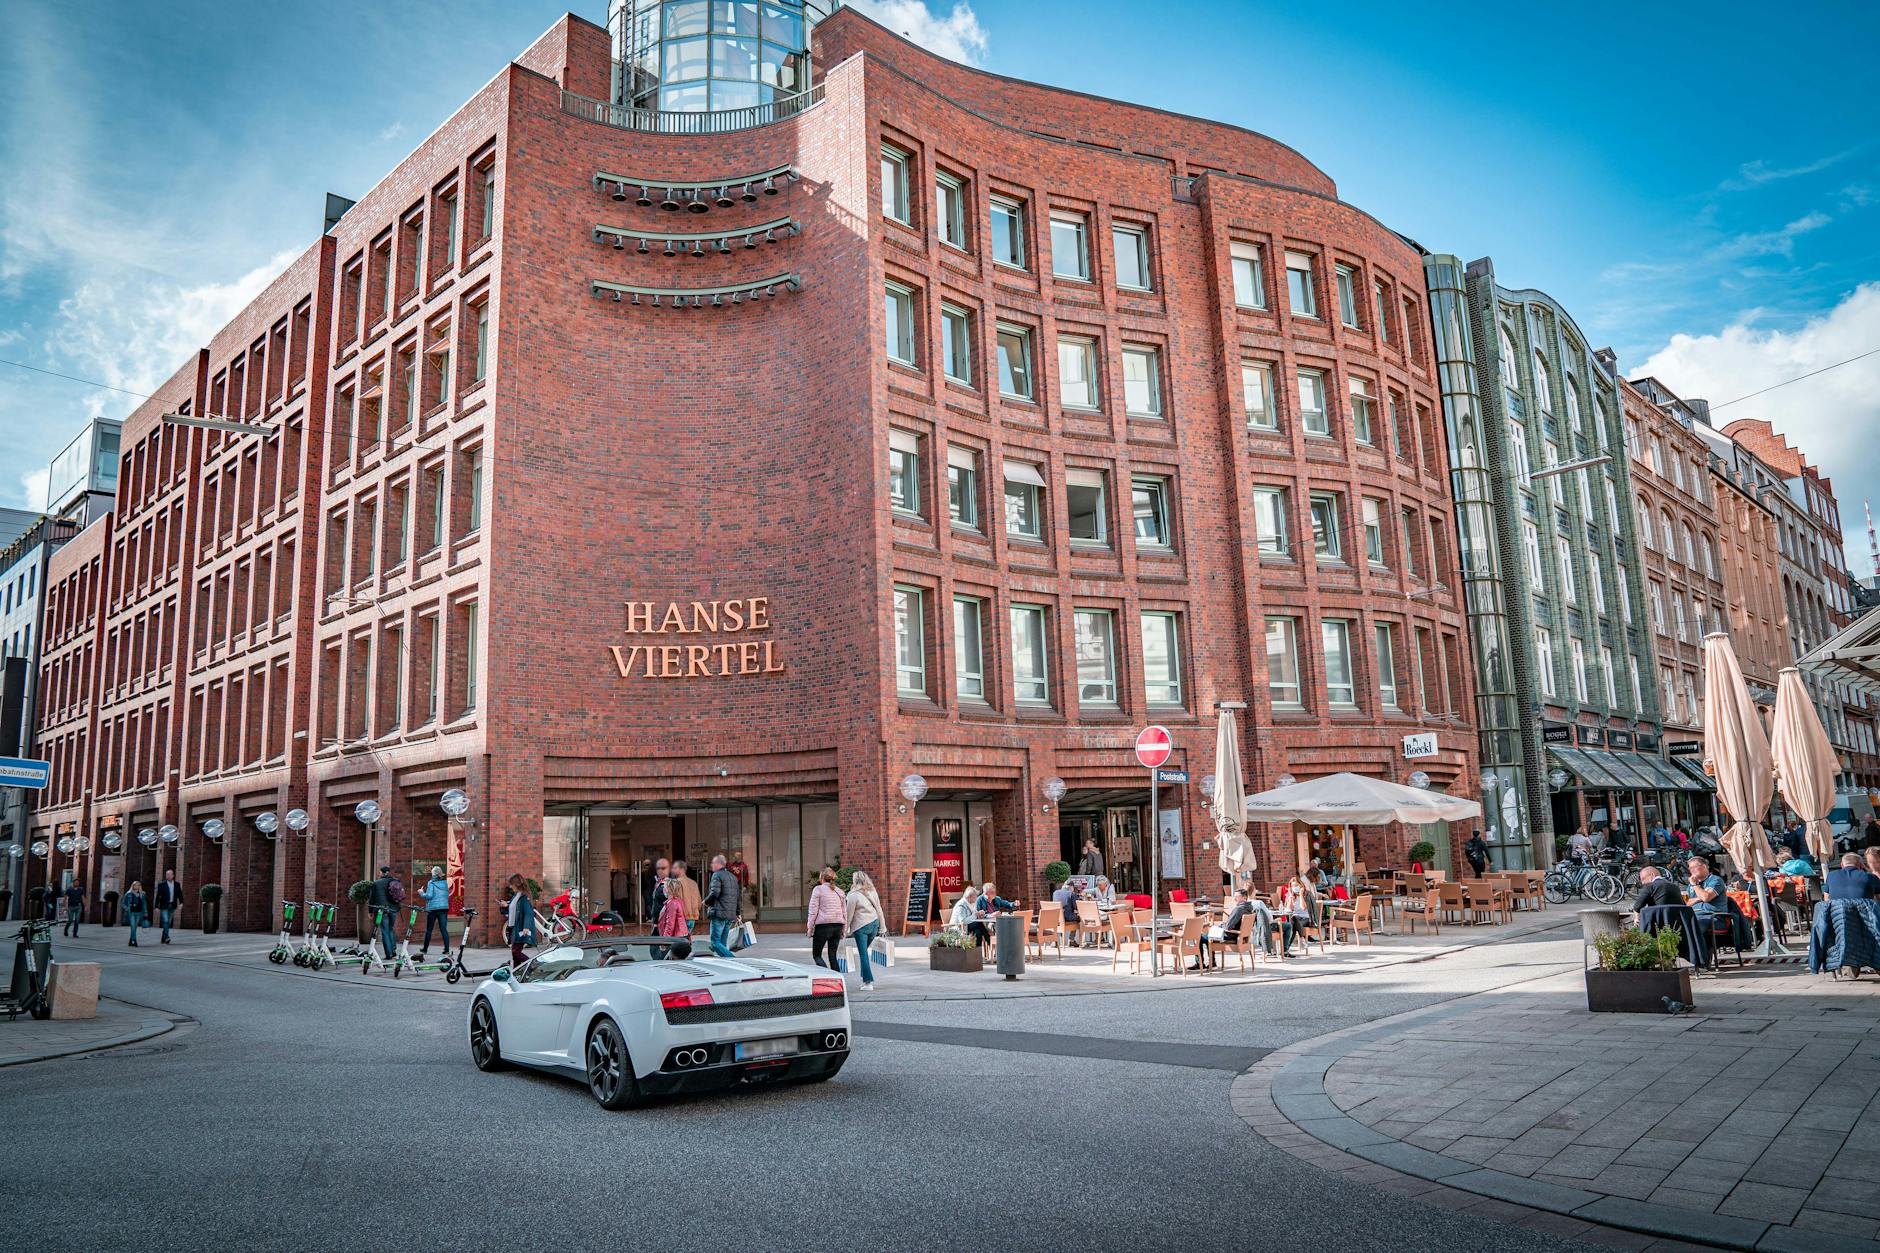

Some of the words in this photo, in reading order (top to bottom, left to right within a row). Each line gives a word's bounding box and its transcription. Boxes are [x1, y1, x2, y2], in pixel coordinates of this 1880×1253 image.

[624, 597, 769, 633] HANSE
[608, 640, 784, 678] VIERTEL
[1406, 741, 1432, 755] Roeckl
[933, 859, 960, 867] MARKEN
[938, 876, 961, 887] TORE
